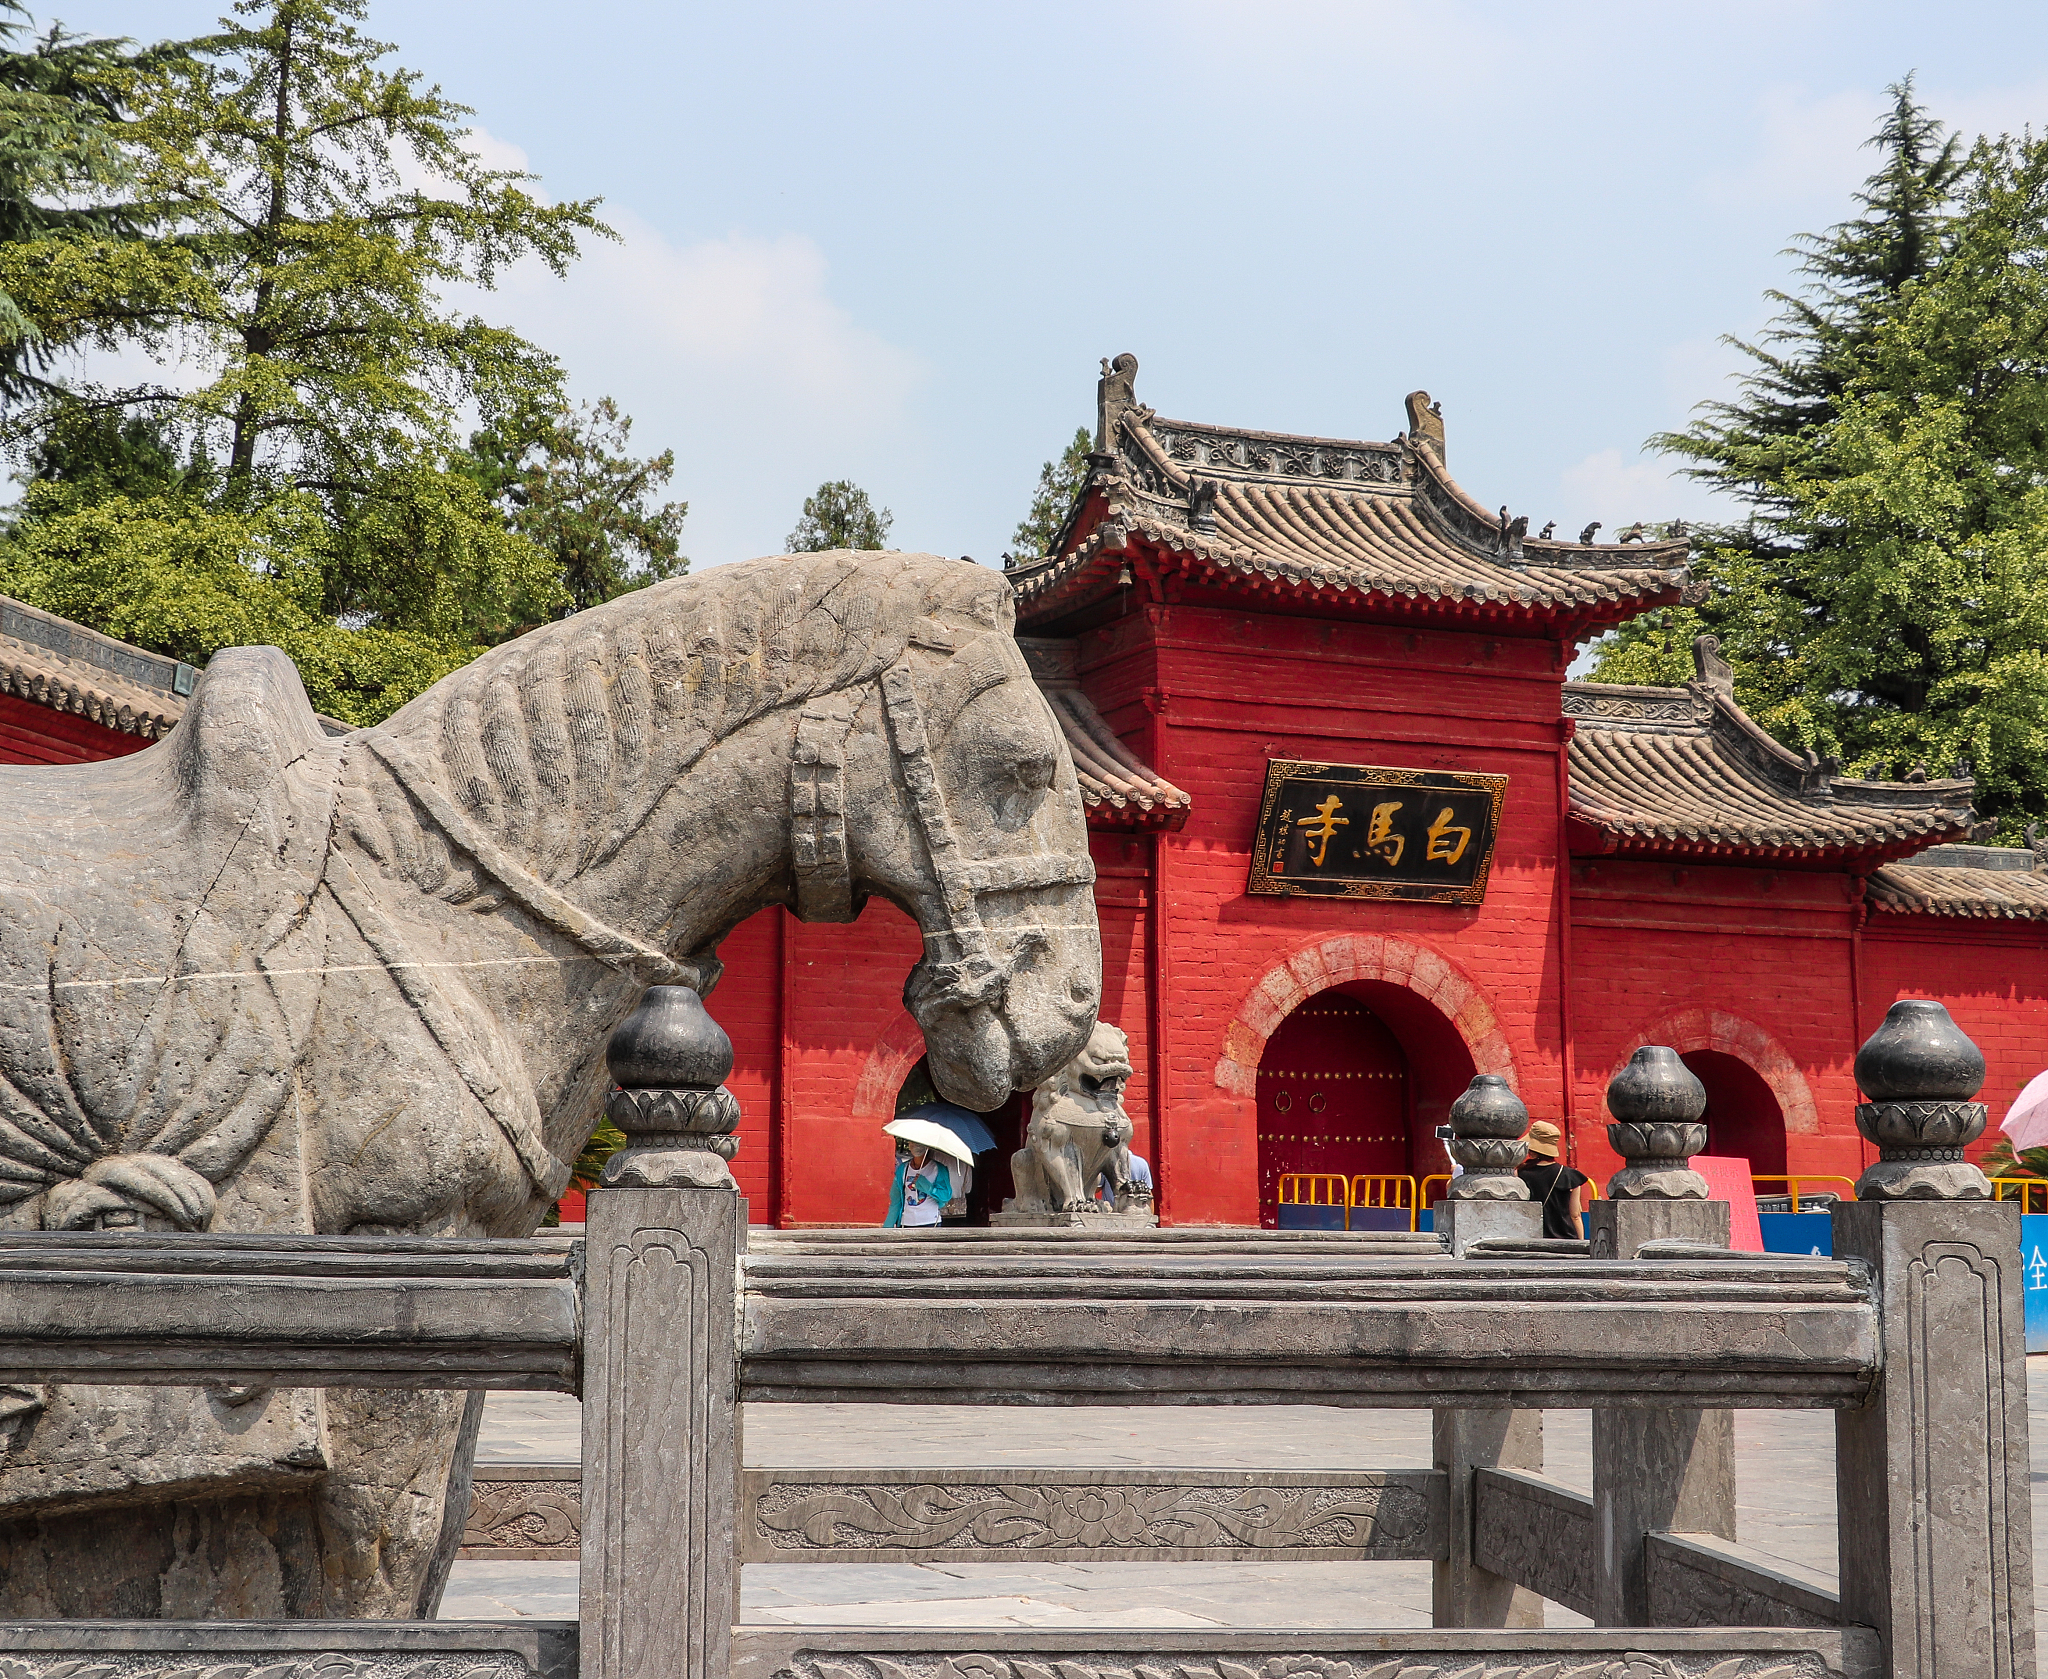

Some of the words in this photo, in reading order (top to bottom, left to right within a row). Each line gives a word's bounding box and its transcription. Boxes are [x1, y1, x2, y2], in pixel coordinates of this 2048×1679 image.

[1296, 794, 1472, 867] 白馬寺
[2022, 1245, 2048, 1290] 全
